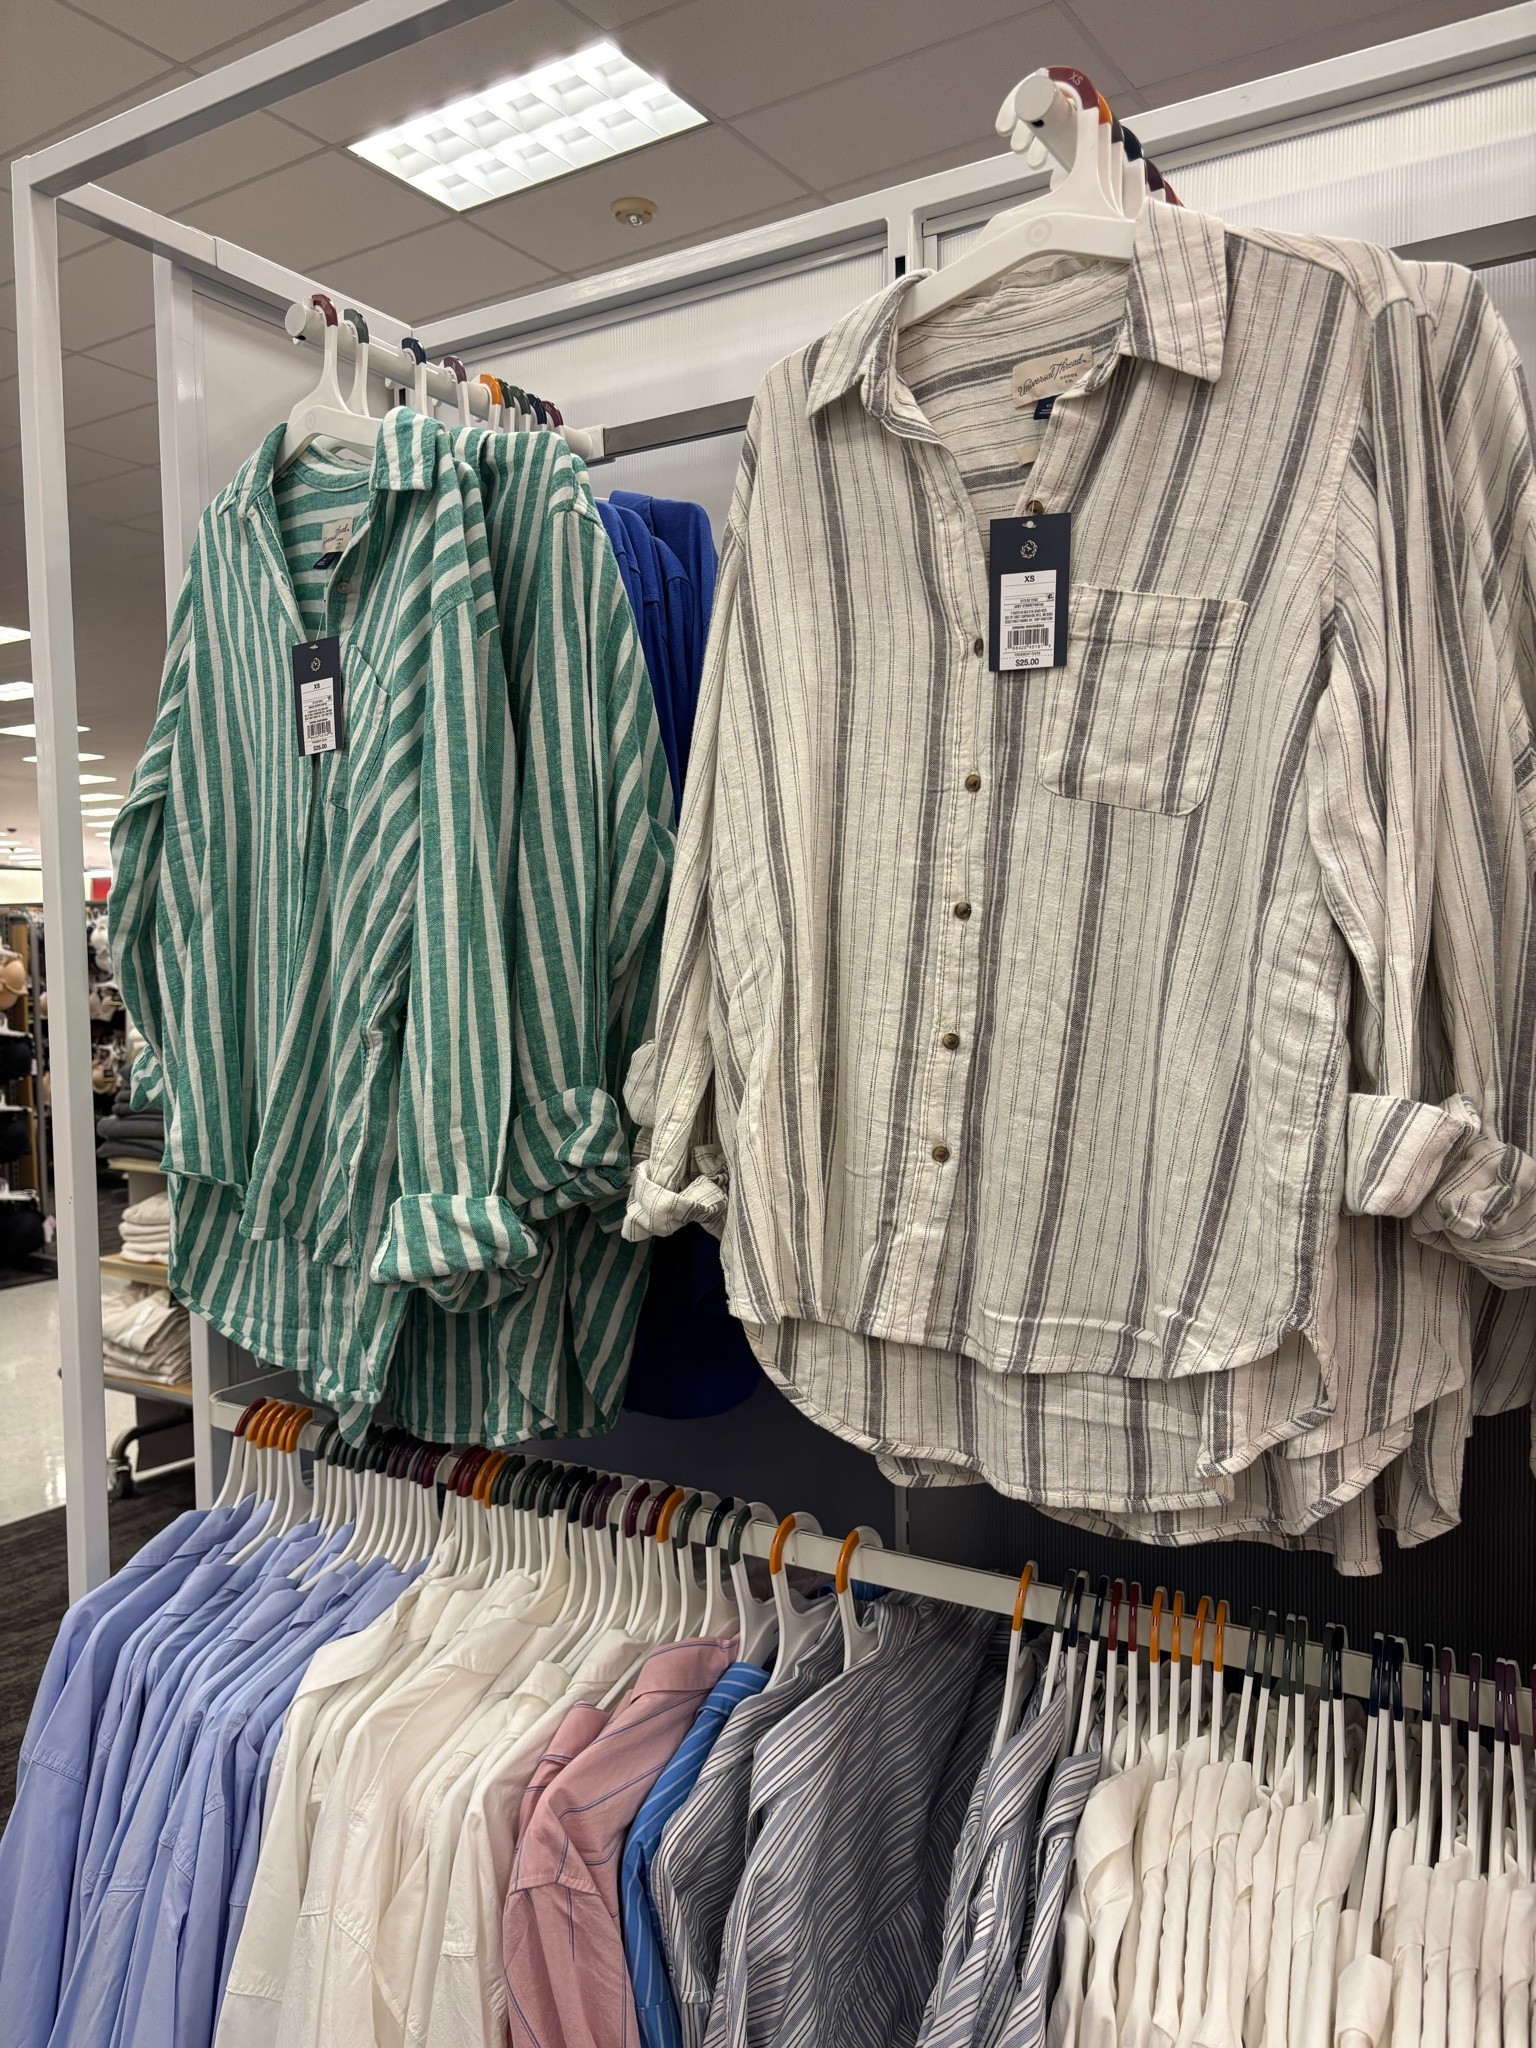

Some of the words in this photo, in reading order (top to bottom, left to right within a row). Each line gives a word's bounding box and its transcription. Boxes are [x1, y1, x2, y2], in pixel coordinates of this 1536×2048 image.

[1068, 71, 1084, 87] XS
[1017, 367, 1055, 397] Universal
[1049, 353, 1084, 380] Thread
[1024, 575, 1035, 583] XS
[1015, 657, 1040, 667] $25.00
[313, 743, 328, 752] $25.00
